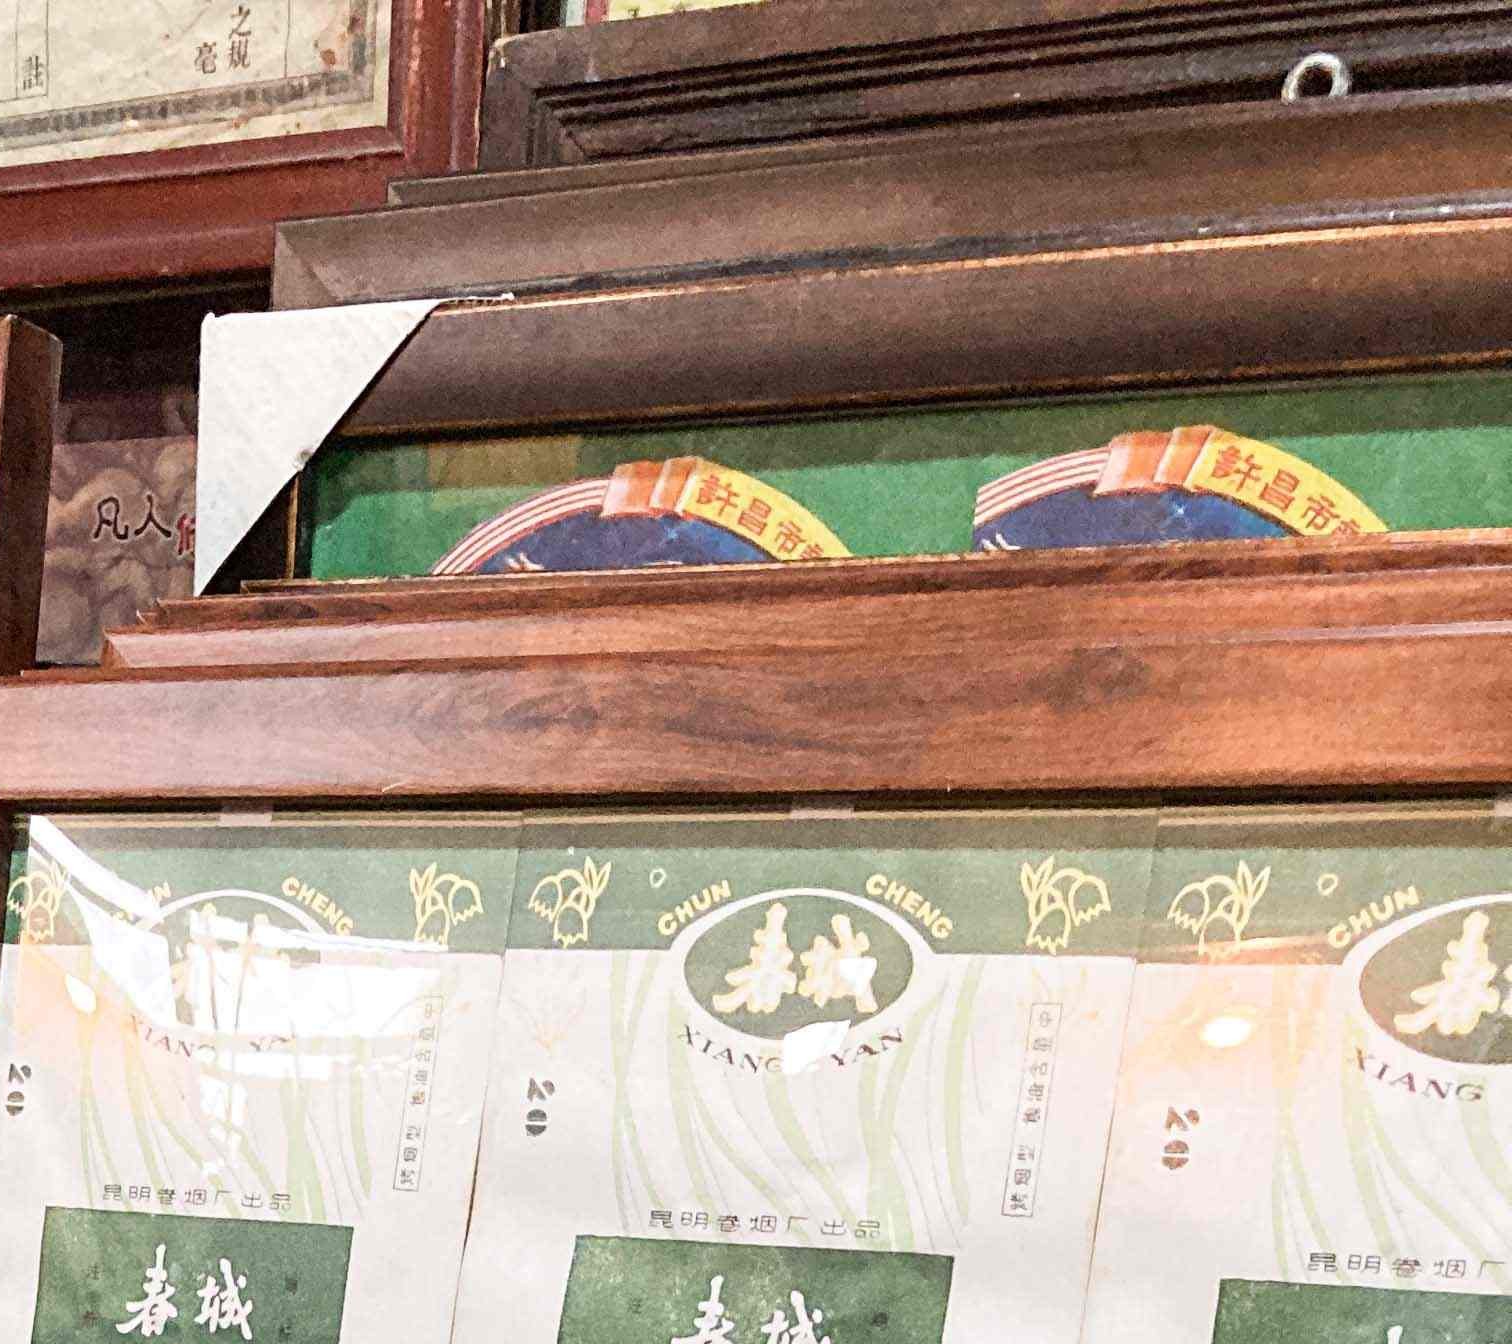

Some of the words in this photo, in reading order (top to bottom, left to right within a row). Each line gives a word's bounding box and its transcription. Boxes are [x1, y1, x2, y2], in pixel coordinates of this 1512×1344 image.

[281, 877, 354, 937] CHENG
[658, 880, 732, 937] CHUN
[865, 874, 954, 940] CHENG
[1329, 886, 1418, 949] CHUN
[677, 1024, 782, 1073] XIANG
[832, 1027, 905, 1068] YAN
[1353, 1046, 1485, 1102] XIANG
[116, 1244, 253, 1340] 春城
